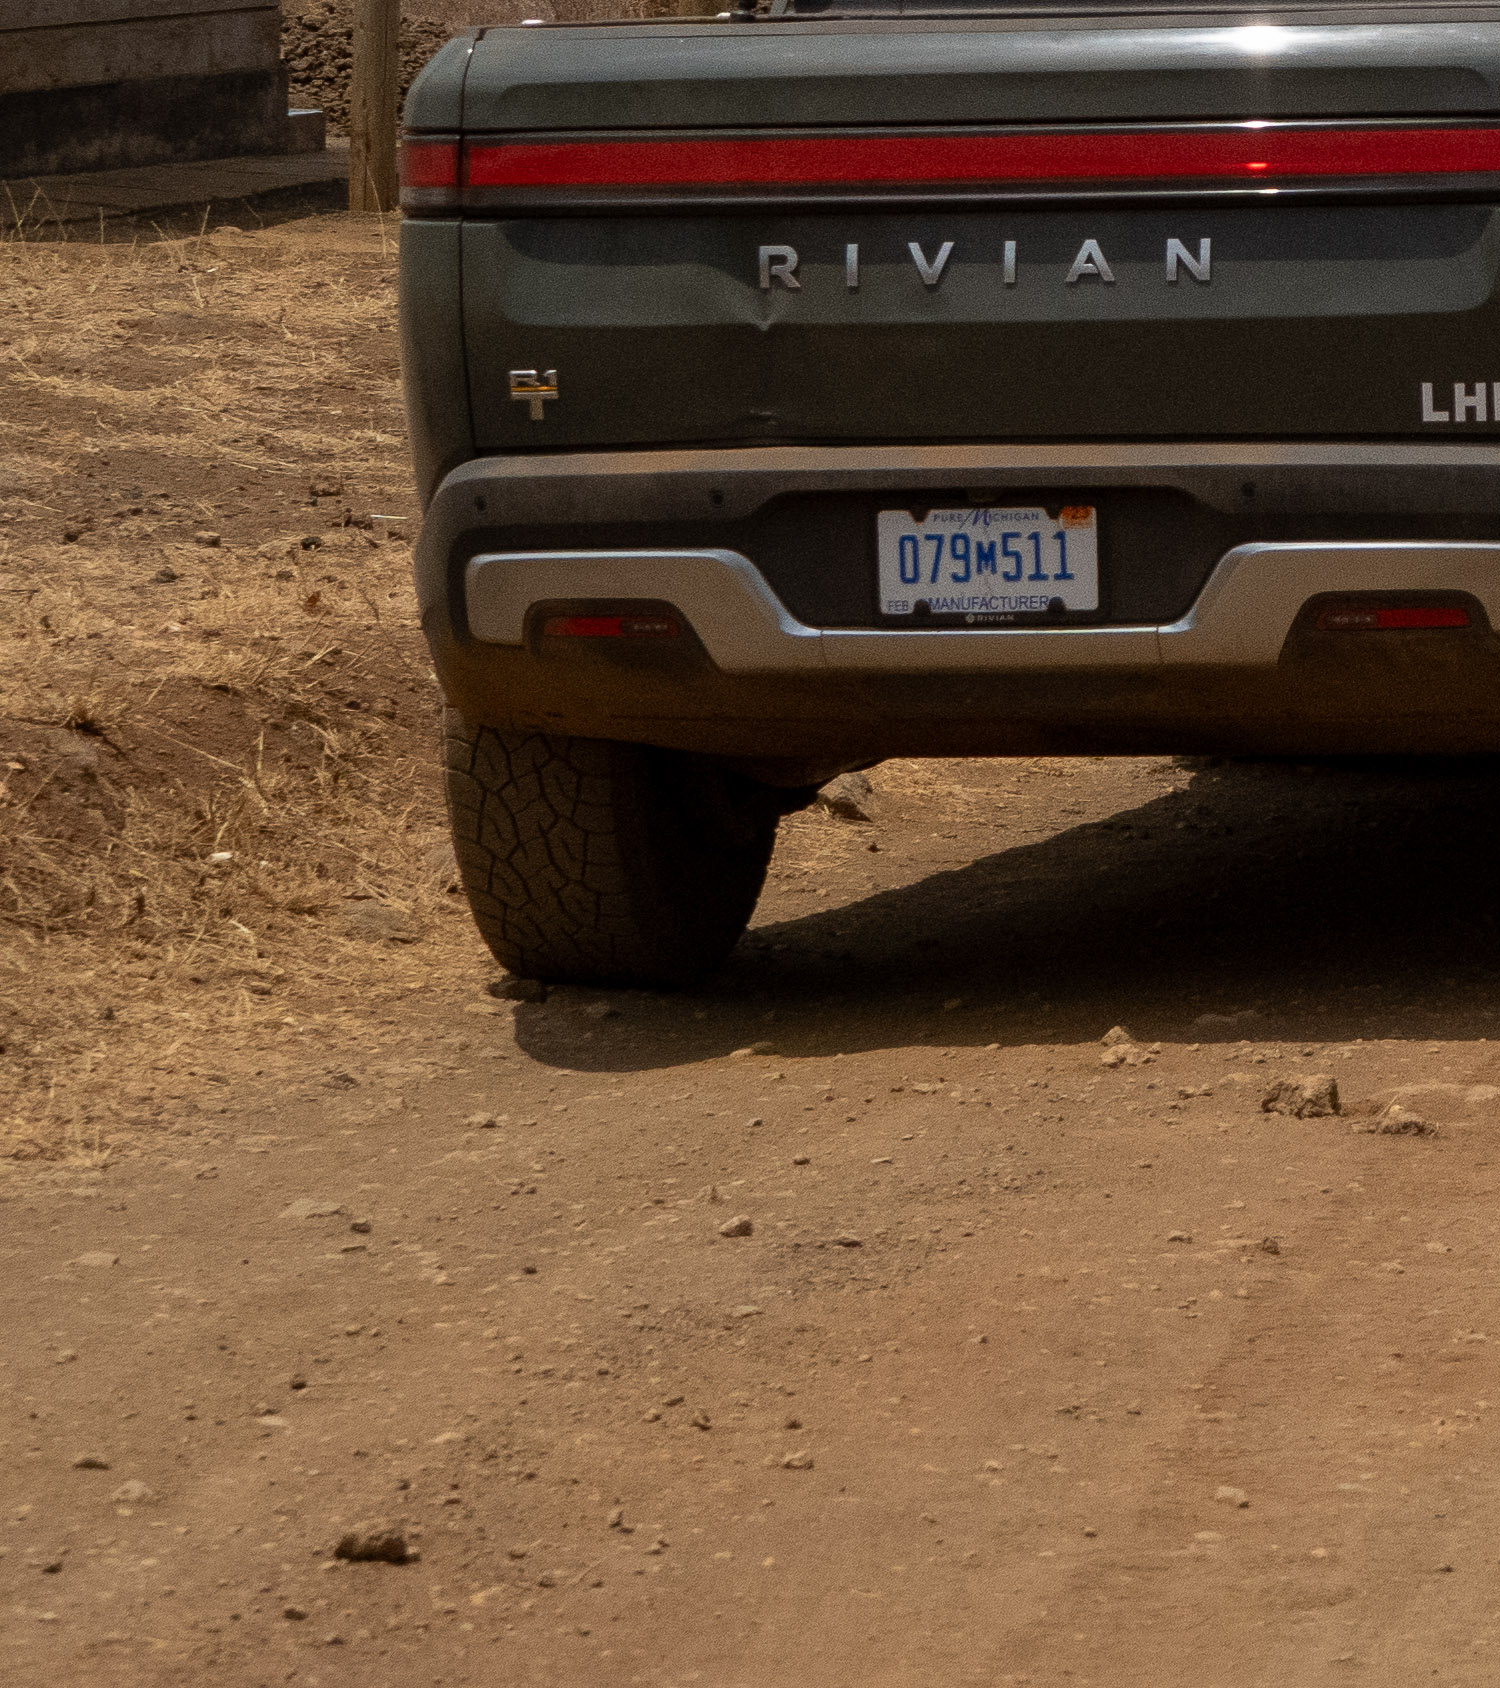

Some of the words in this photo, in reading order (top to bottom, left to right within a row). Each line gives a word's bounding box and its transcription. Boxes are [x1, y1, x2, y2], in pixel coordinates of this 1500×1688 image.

[758, 238, 1212, 289] RIVIAN
[933, 513, 964, 523] PURE
[962, 508, 1039, 527] MICHIGAN
[899, 531, 1075, 585] 079M511
[887, 600, 910, 612] FEB
[928, 596, 1049, 611] MANUFACTURER
